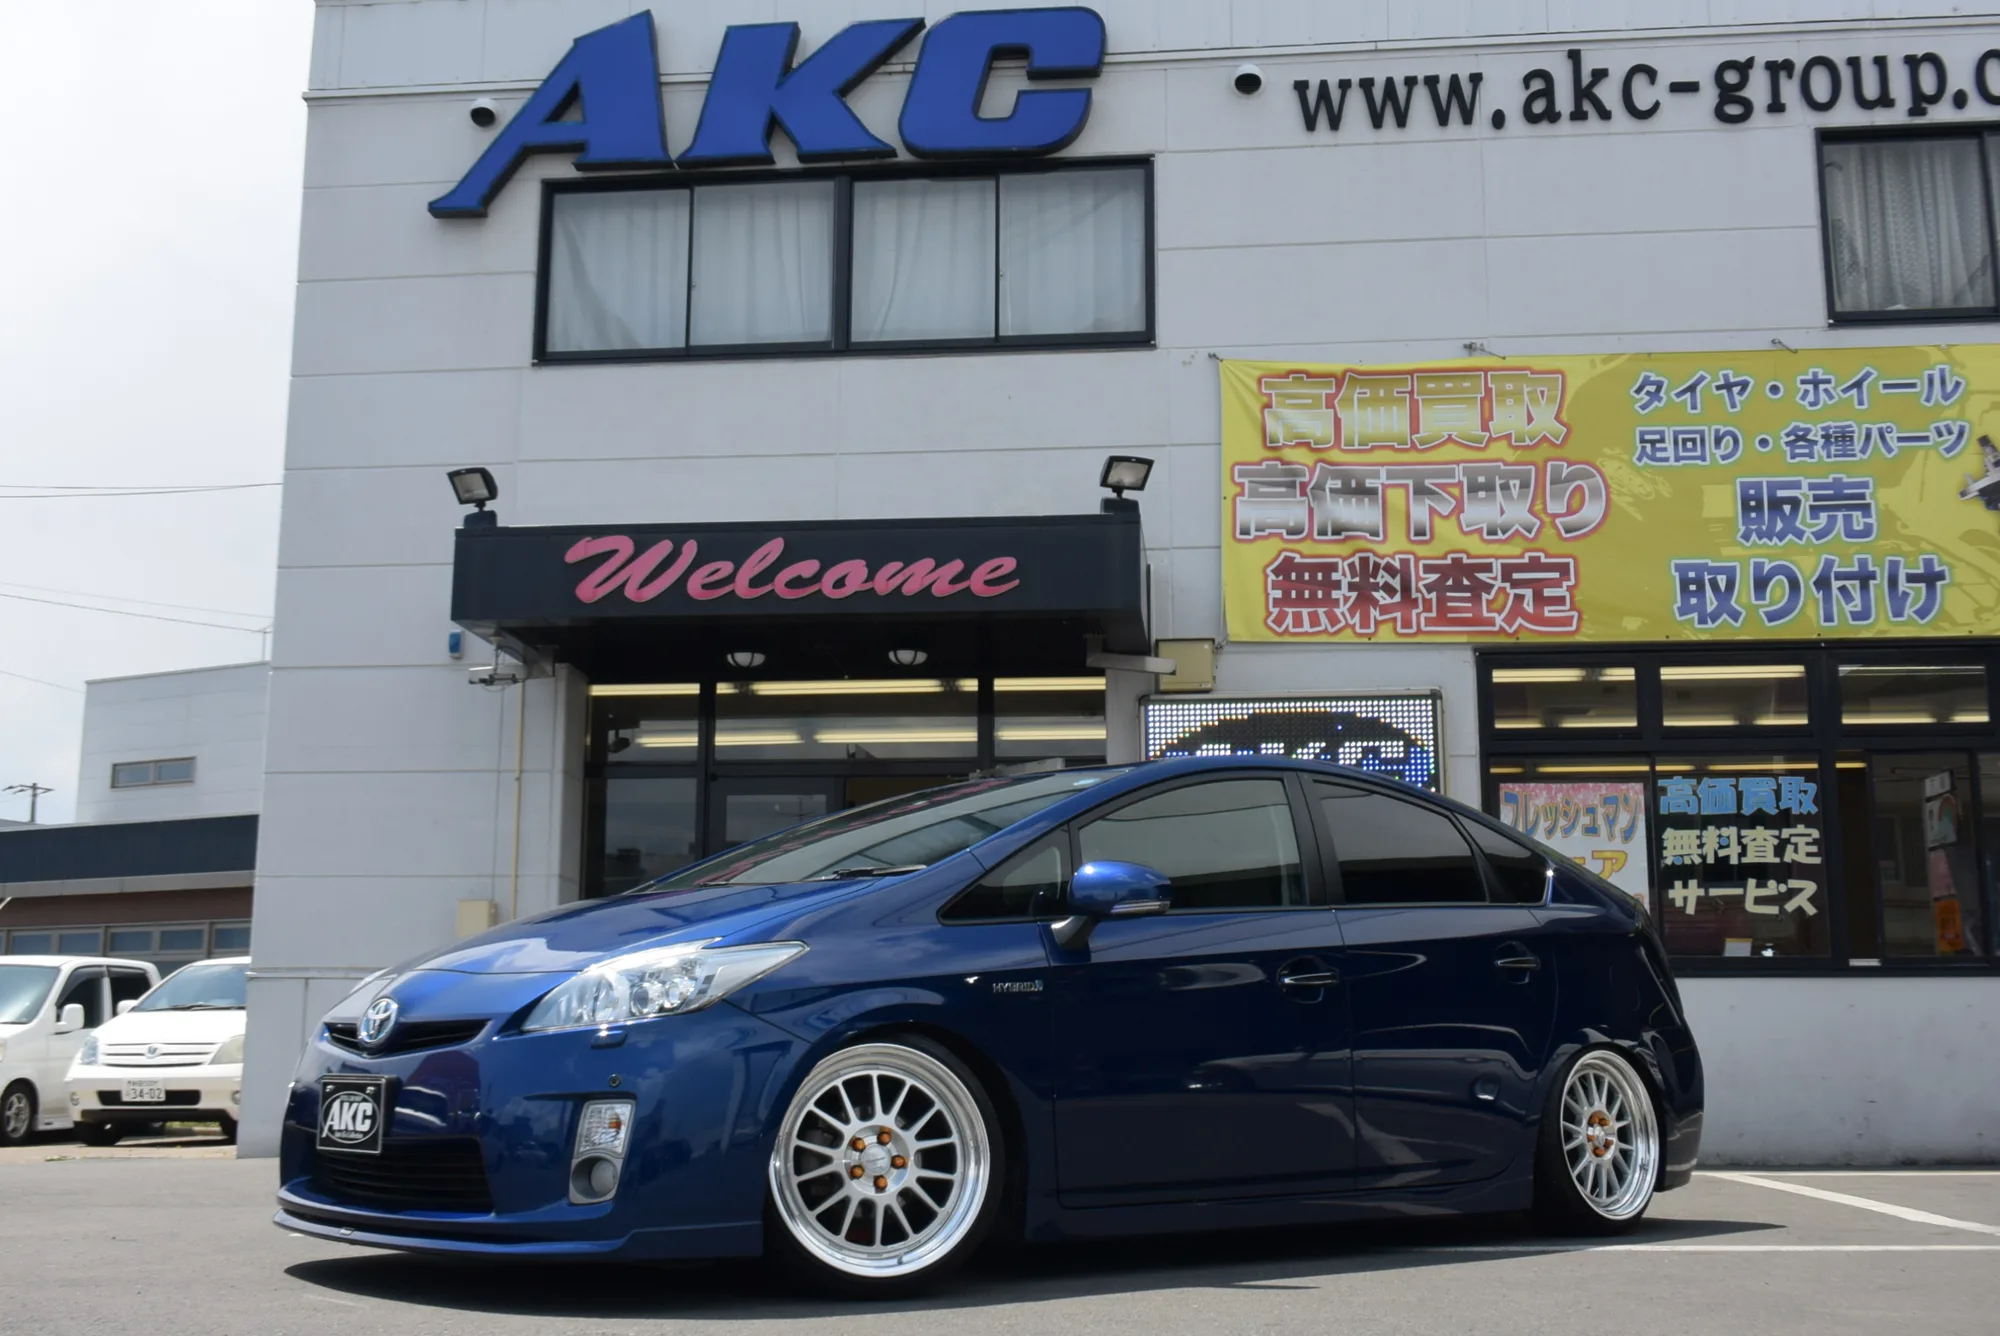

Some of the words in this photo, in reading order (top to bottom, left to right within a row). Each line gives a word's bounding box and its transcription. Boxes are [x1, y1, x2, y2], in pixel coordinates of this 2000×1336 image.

[428, 6, 1106, 219] AKC
[1261, 369, 1568, 450] 高価買取
[1632, 366, 1965, 413] タイヤ・ホイール
[1634, 420, 1969, 466] 足回り・各種パーツ
[1232, 460, 1608, 541] 高価下取り
[1736, 475, 1877, 546] 販売
[564, 535, 1020, 603] Welcome
[1266, 552, 1581, 634] 無料査定
[1672, 556, 1949, 628] 取り付け
[1657, 776, 1819, 816] 高価買取
[1661, 824, 1822, 866] 無料査定
[1668, 878, 1819, 916] サービス
[992, 982, 1036, 992] HYBRID
[321, 1099, 373, 1138] AKC
